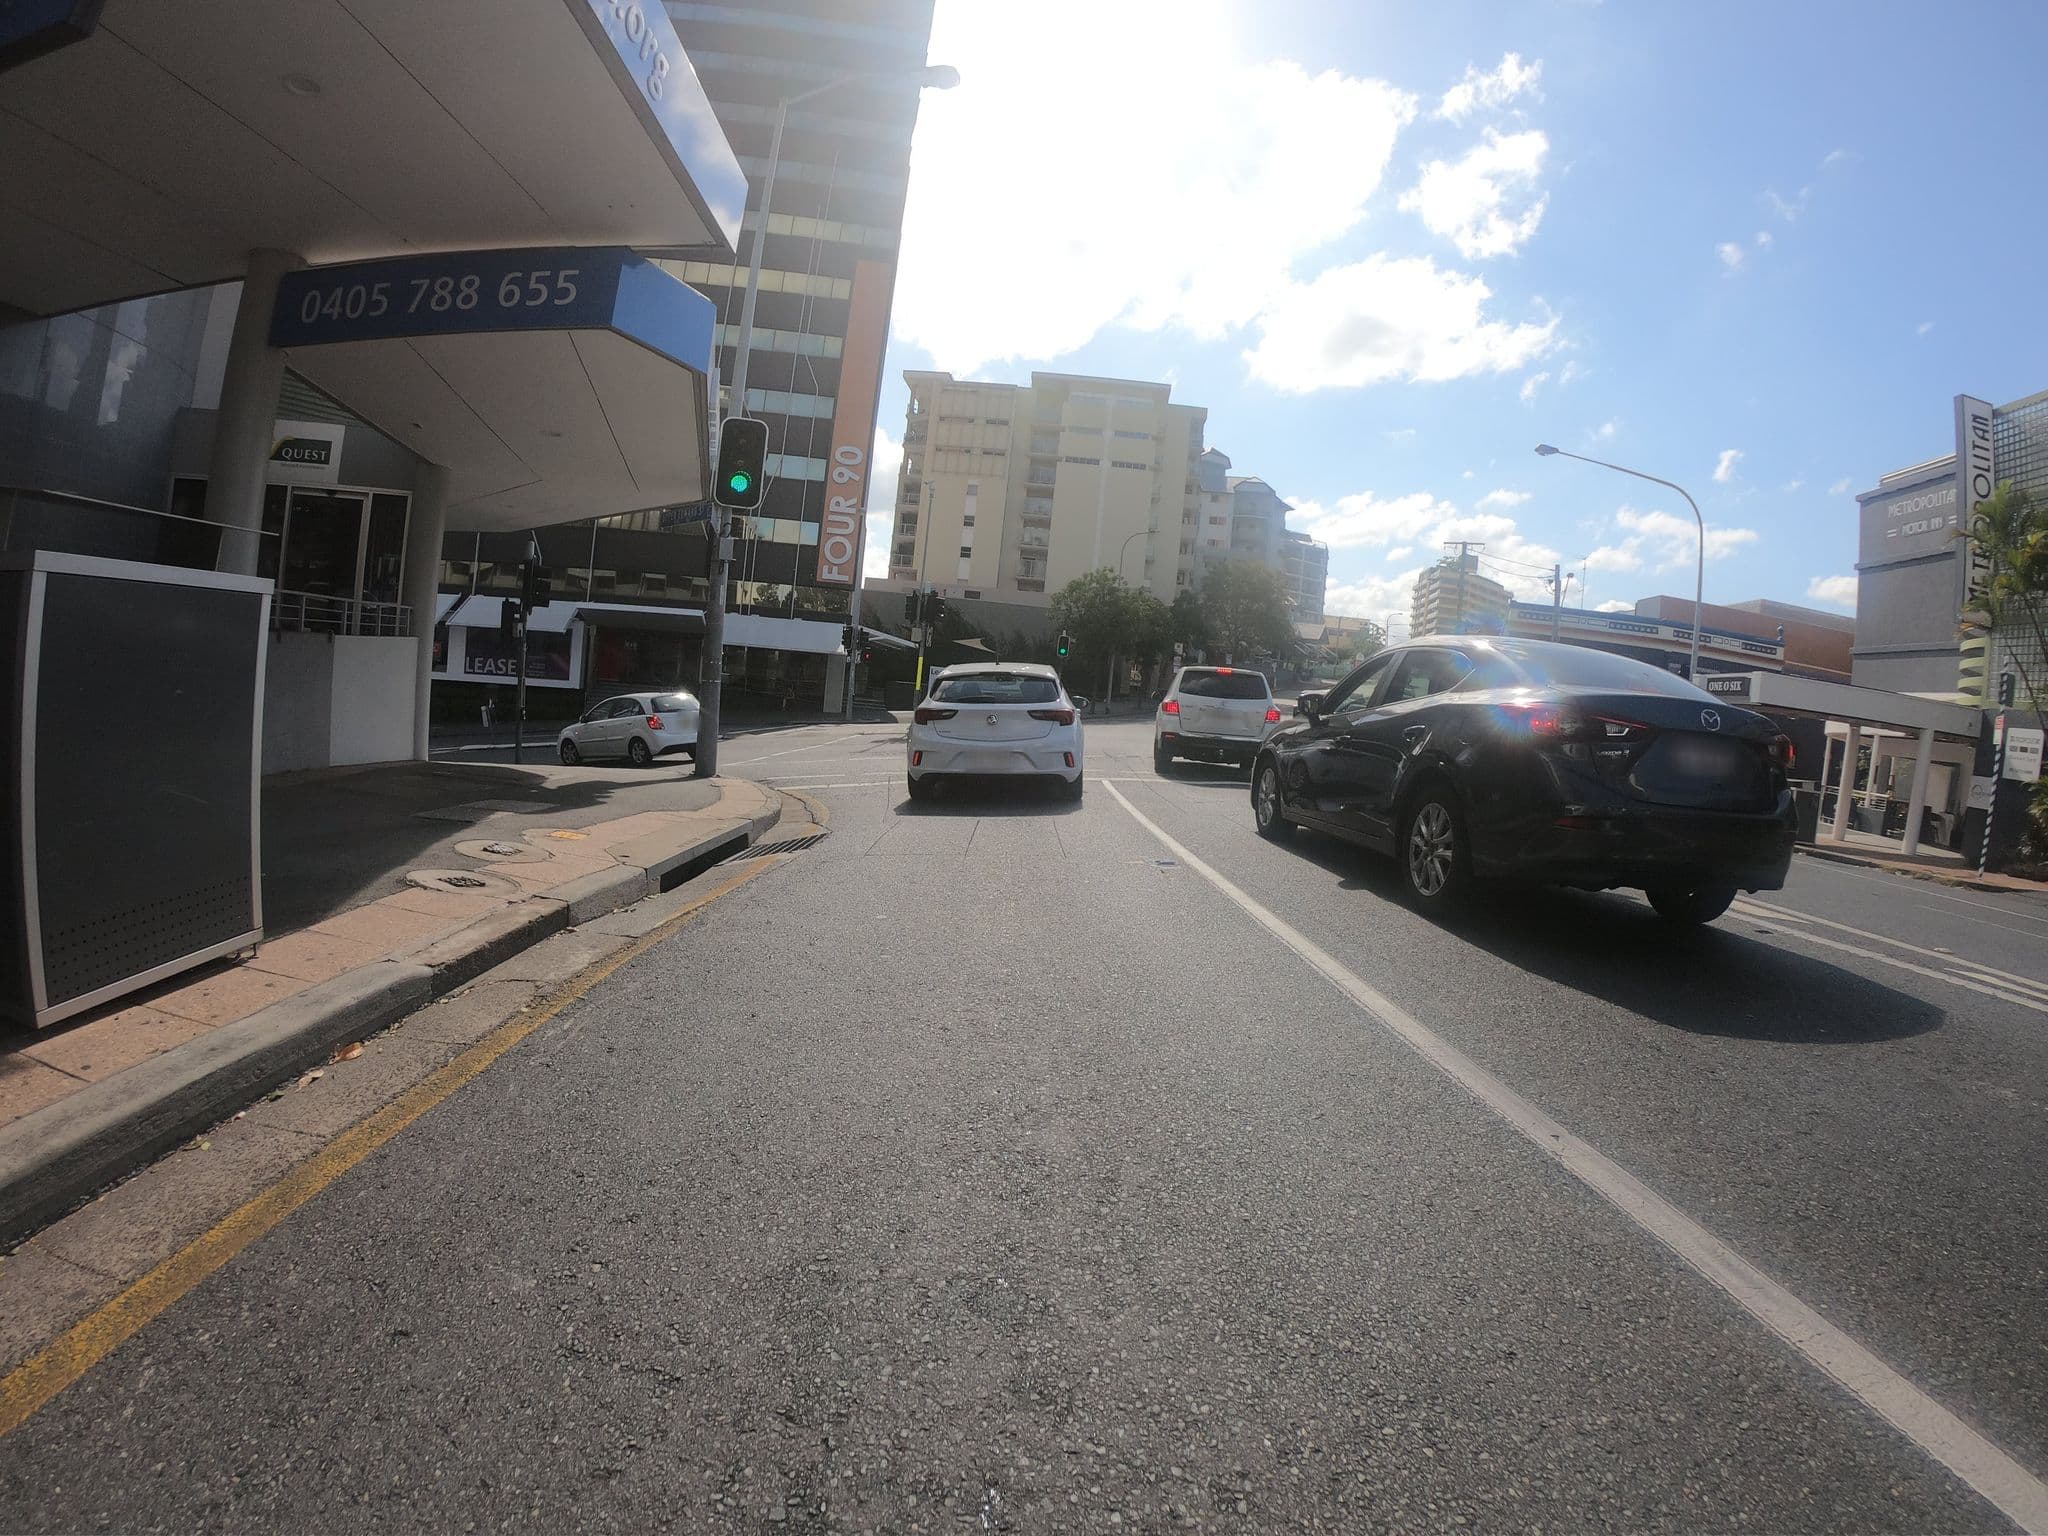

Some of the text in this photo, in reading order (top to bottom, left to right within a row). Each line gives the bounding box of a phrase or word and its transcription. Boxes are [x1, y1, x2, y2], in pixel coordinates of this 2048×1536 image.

[608, 0, 670, 101] .org
[301, 269, 579, 324] 0405 788 655
[281, 447, 327, 461] QUEST
[821, 445, 863, 582] FOUR 90
[1888, 488, 1957, 518] METROPOLITA
[465, 656, 518, 675] LEASE
[1708, 681, 1723, 691] ONE
[1730, 681, 1742, 691] SIX
